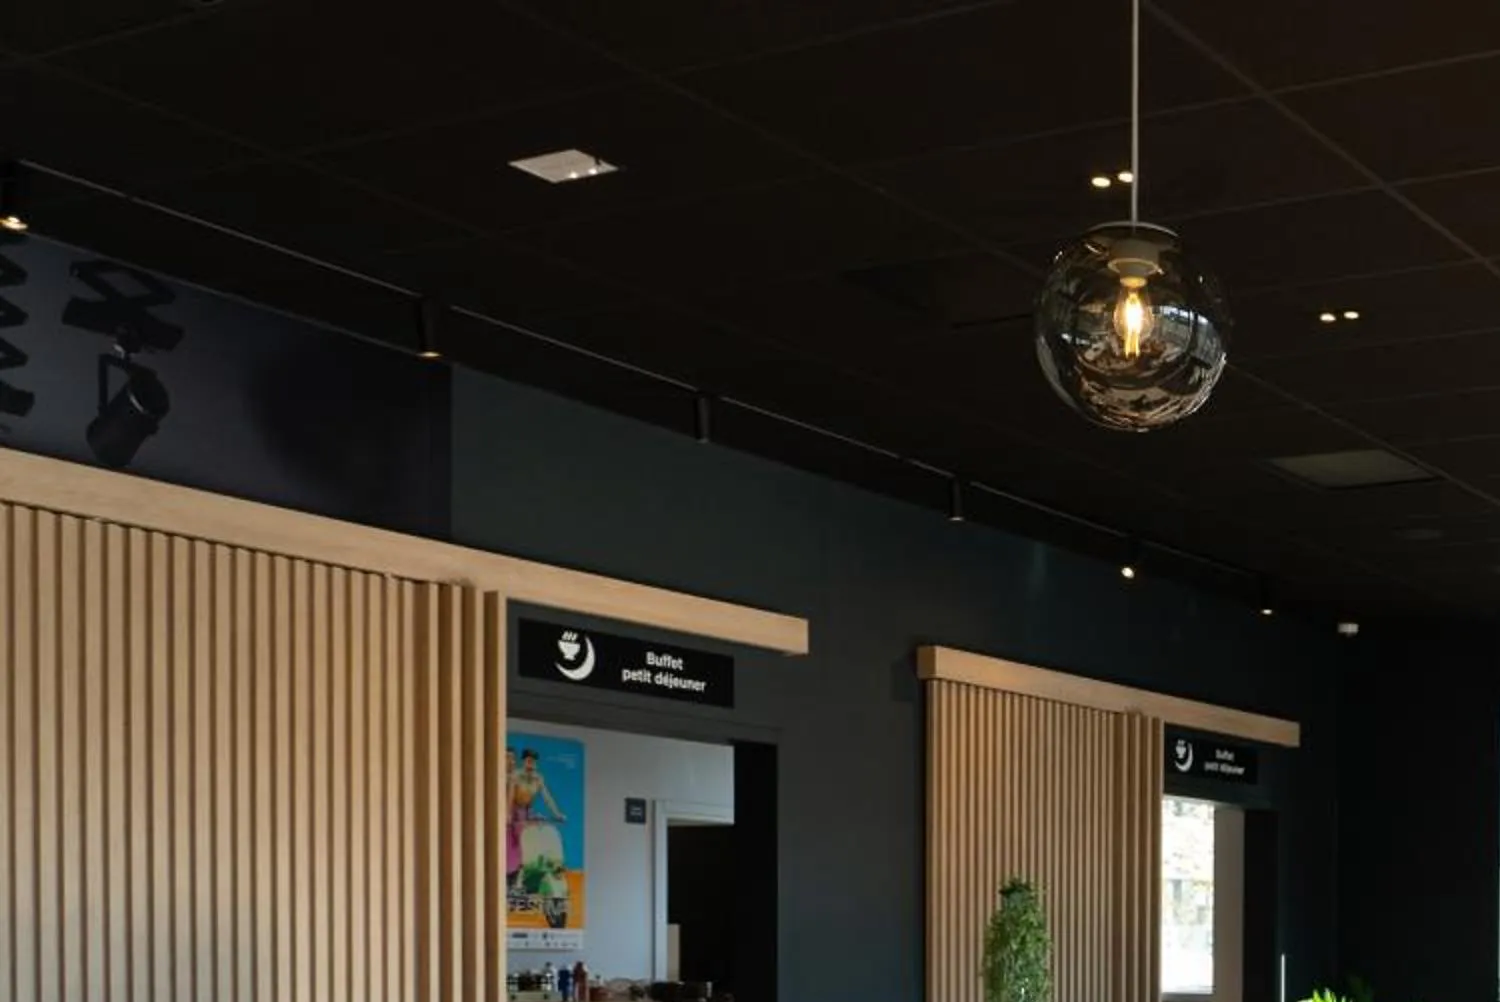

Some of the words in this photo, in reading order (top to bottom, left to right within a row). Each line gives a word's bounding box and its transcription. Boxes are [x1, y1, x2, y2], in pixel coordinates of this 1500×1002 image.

[646, 651, 683, 671] Buffet
[622, 669, 652, 684] petit
[654, 672, 706, 692] déjeuner
